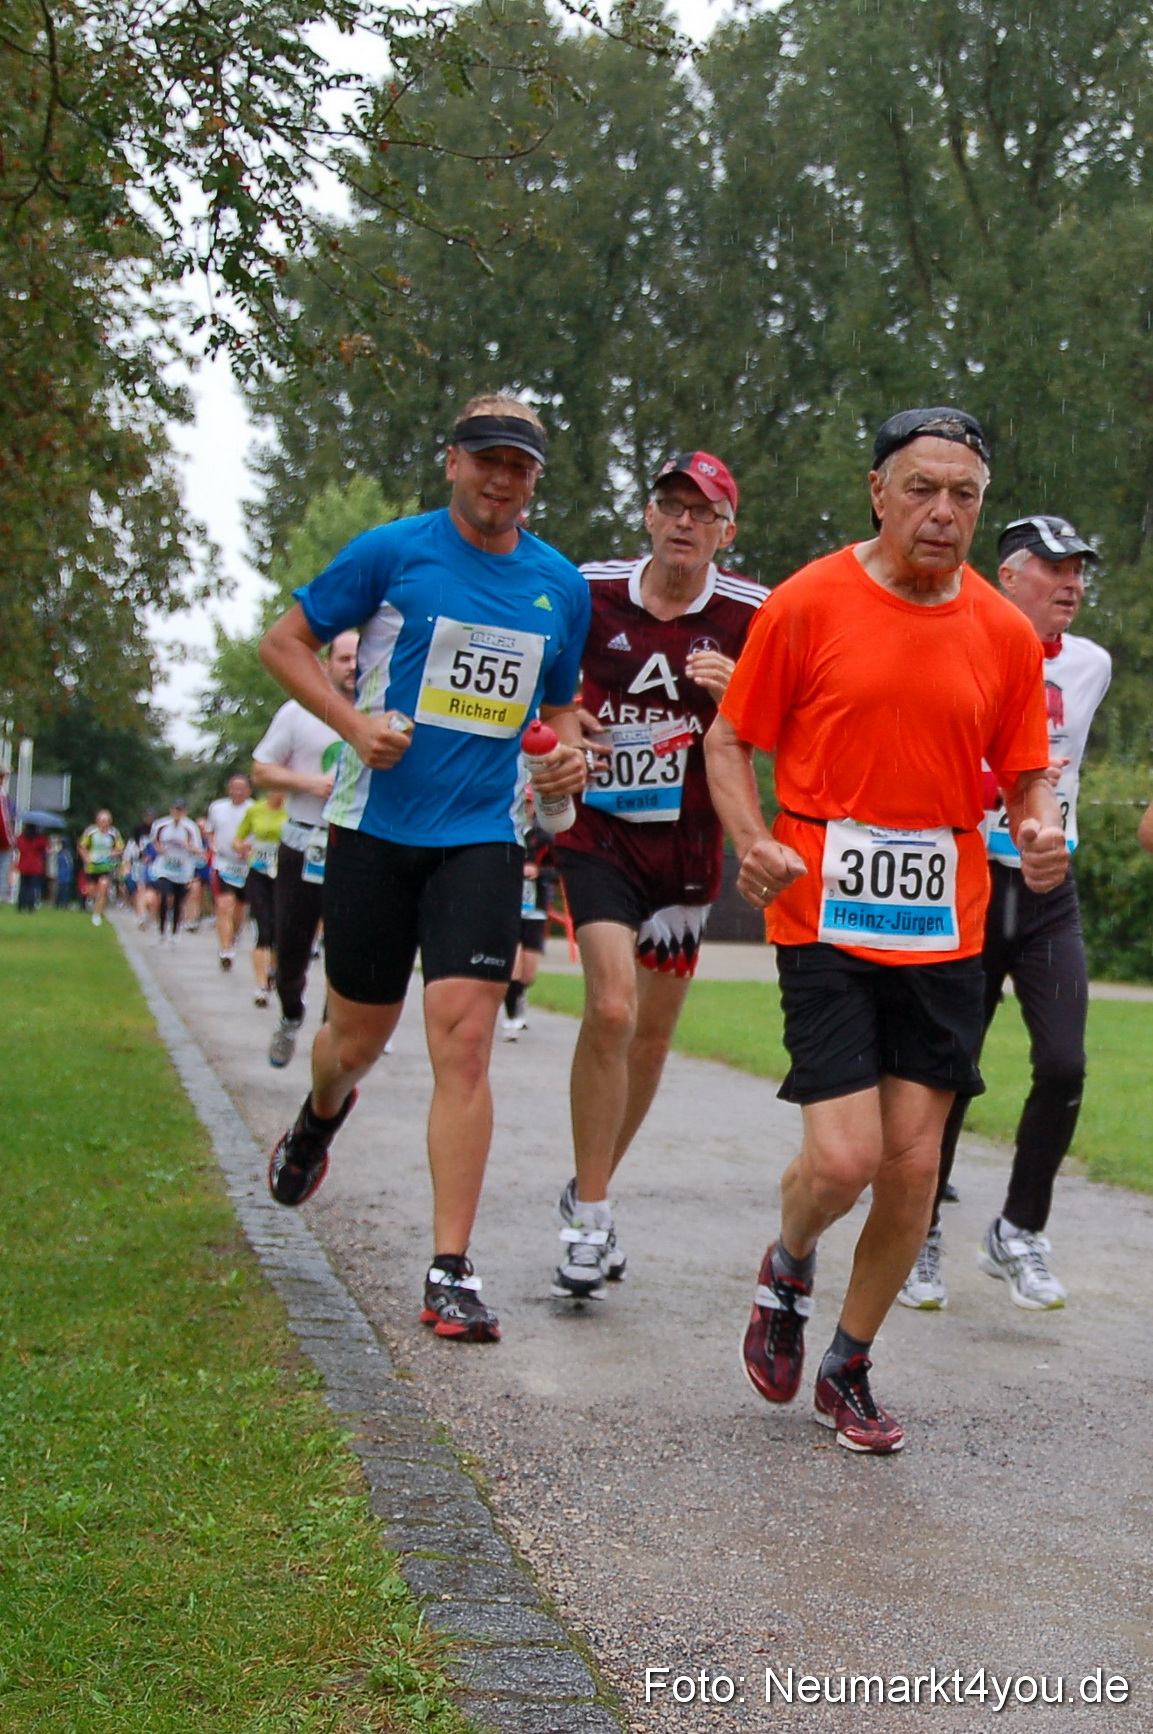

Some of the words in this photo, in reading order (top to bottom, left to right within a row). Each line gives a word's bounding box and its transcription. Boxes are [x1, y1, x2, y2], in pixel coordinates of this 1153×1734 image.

[450, 650, 522, 699] 555
[627, 653, 679, 700] A
[449, 698, 507, 722] Richard
[596, 749, 680, 789] 3023
[616, 794, 658, 809] Ewald
[838, 849, 946, 902] 3058
[833, 906, 945, 935] Heinz-Jürgen
